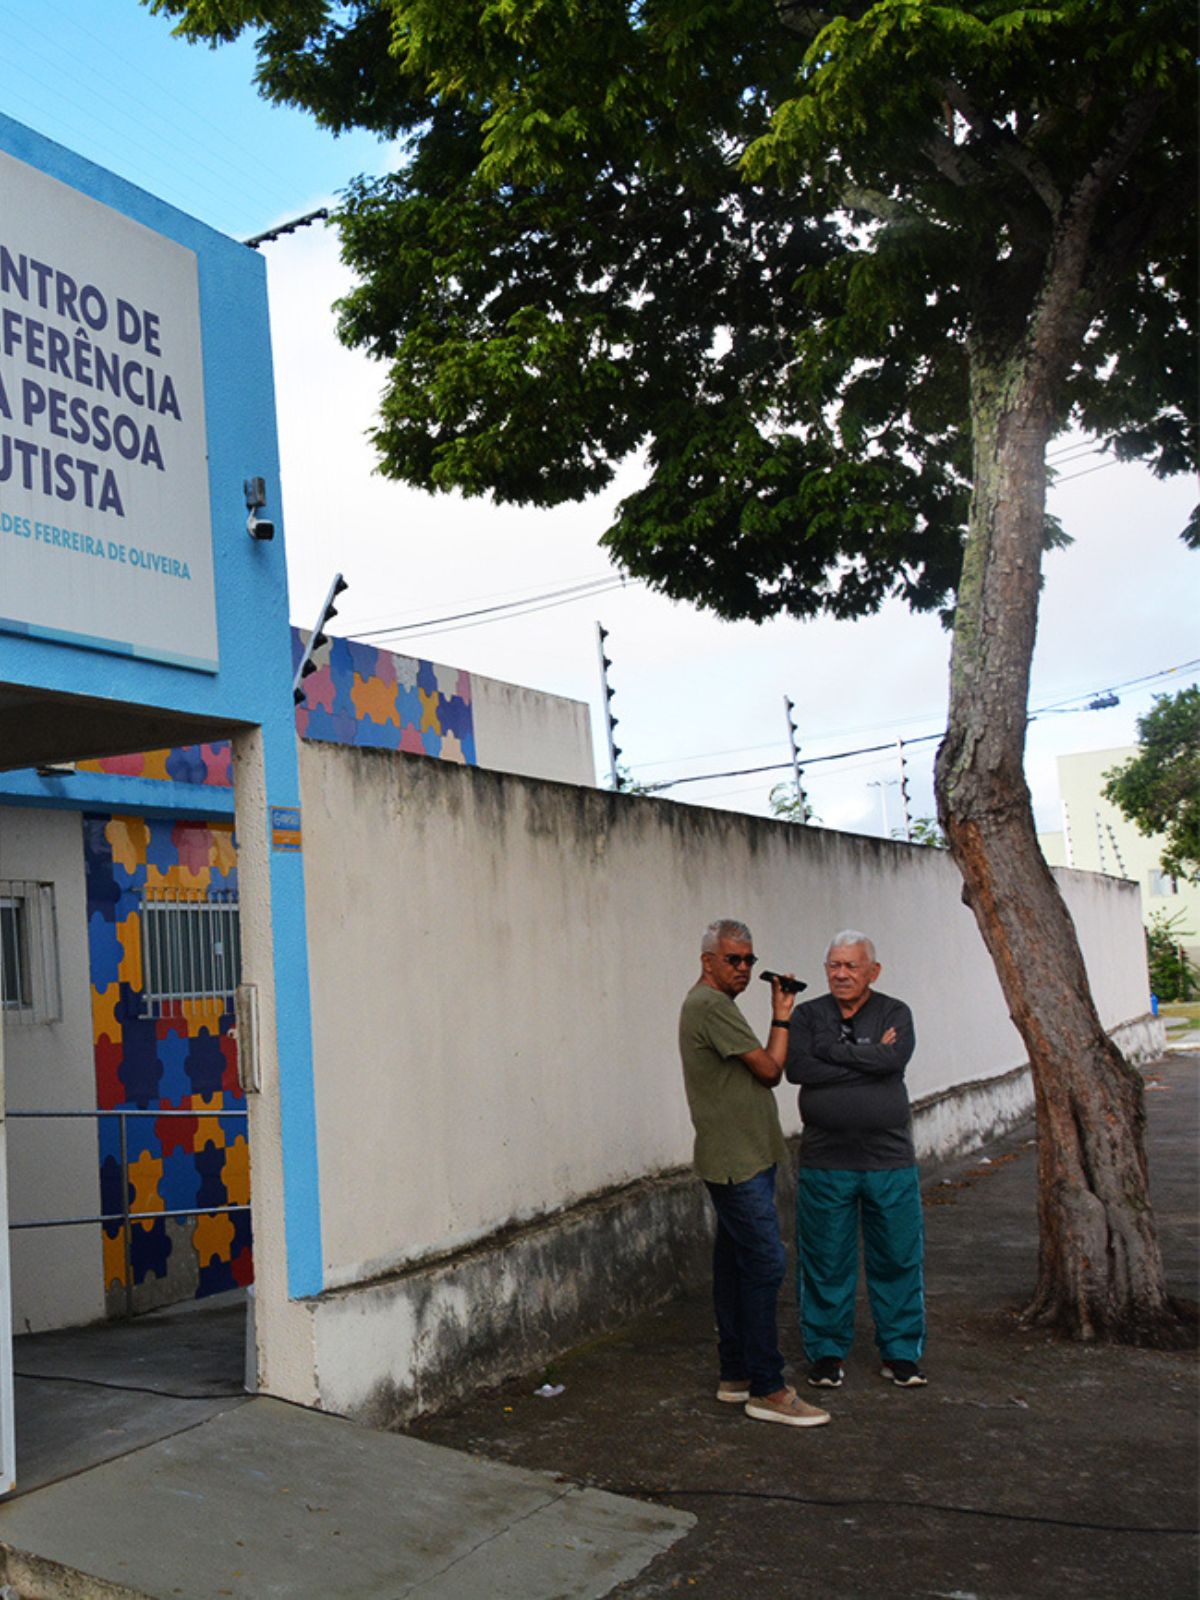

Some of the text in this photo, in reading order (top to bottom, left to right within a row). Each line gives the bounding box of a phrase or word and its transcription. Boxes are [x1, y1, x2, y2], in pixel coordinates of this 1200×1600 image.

[117, 298, 161, 357] DE
[22, 378, 166, 472] PESSOA
[35, 522, 105, 558] FERREIRA
[108, 546, 127, 565] DE
[130, 549, 191, 580] OLIVEIRA
